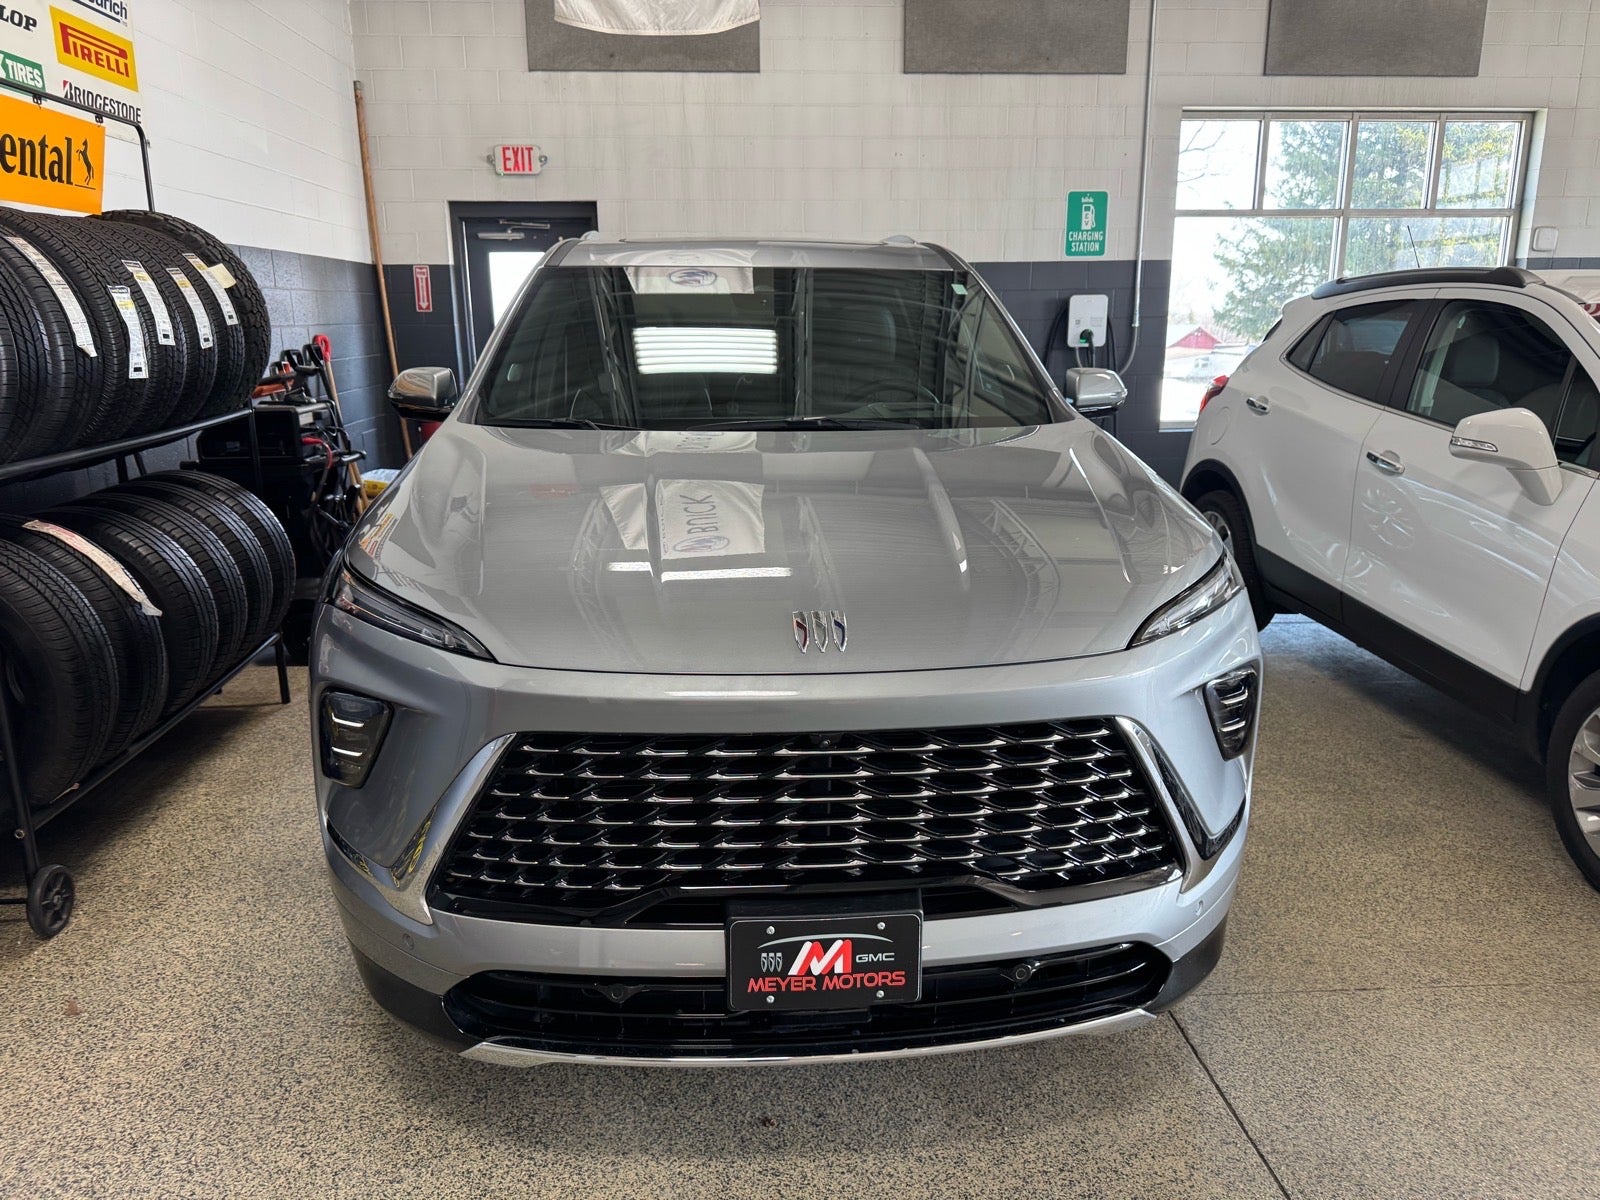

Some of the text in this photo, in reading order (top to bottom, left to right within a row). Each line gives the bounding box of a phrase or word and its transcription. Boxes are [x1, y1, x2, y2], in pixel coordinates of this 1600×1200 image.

[59, 22, 129, 77] PIRELLI
[5, 58, 43, 89] TIRES
[63, 80, 141, 124] BRIDGESTONE
[0, 133, 74, 186] ental
[502, 147, 533, 172] EXIT
[1068, 231, 1103, 242] CHARGING
[1071, 241, 1100, 253] STATION
[855, 952, 895, 963] GMC
[747, 971, 906, 993] MEYER MOTORS
